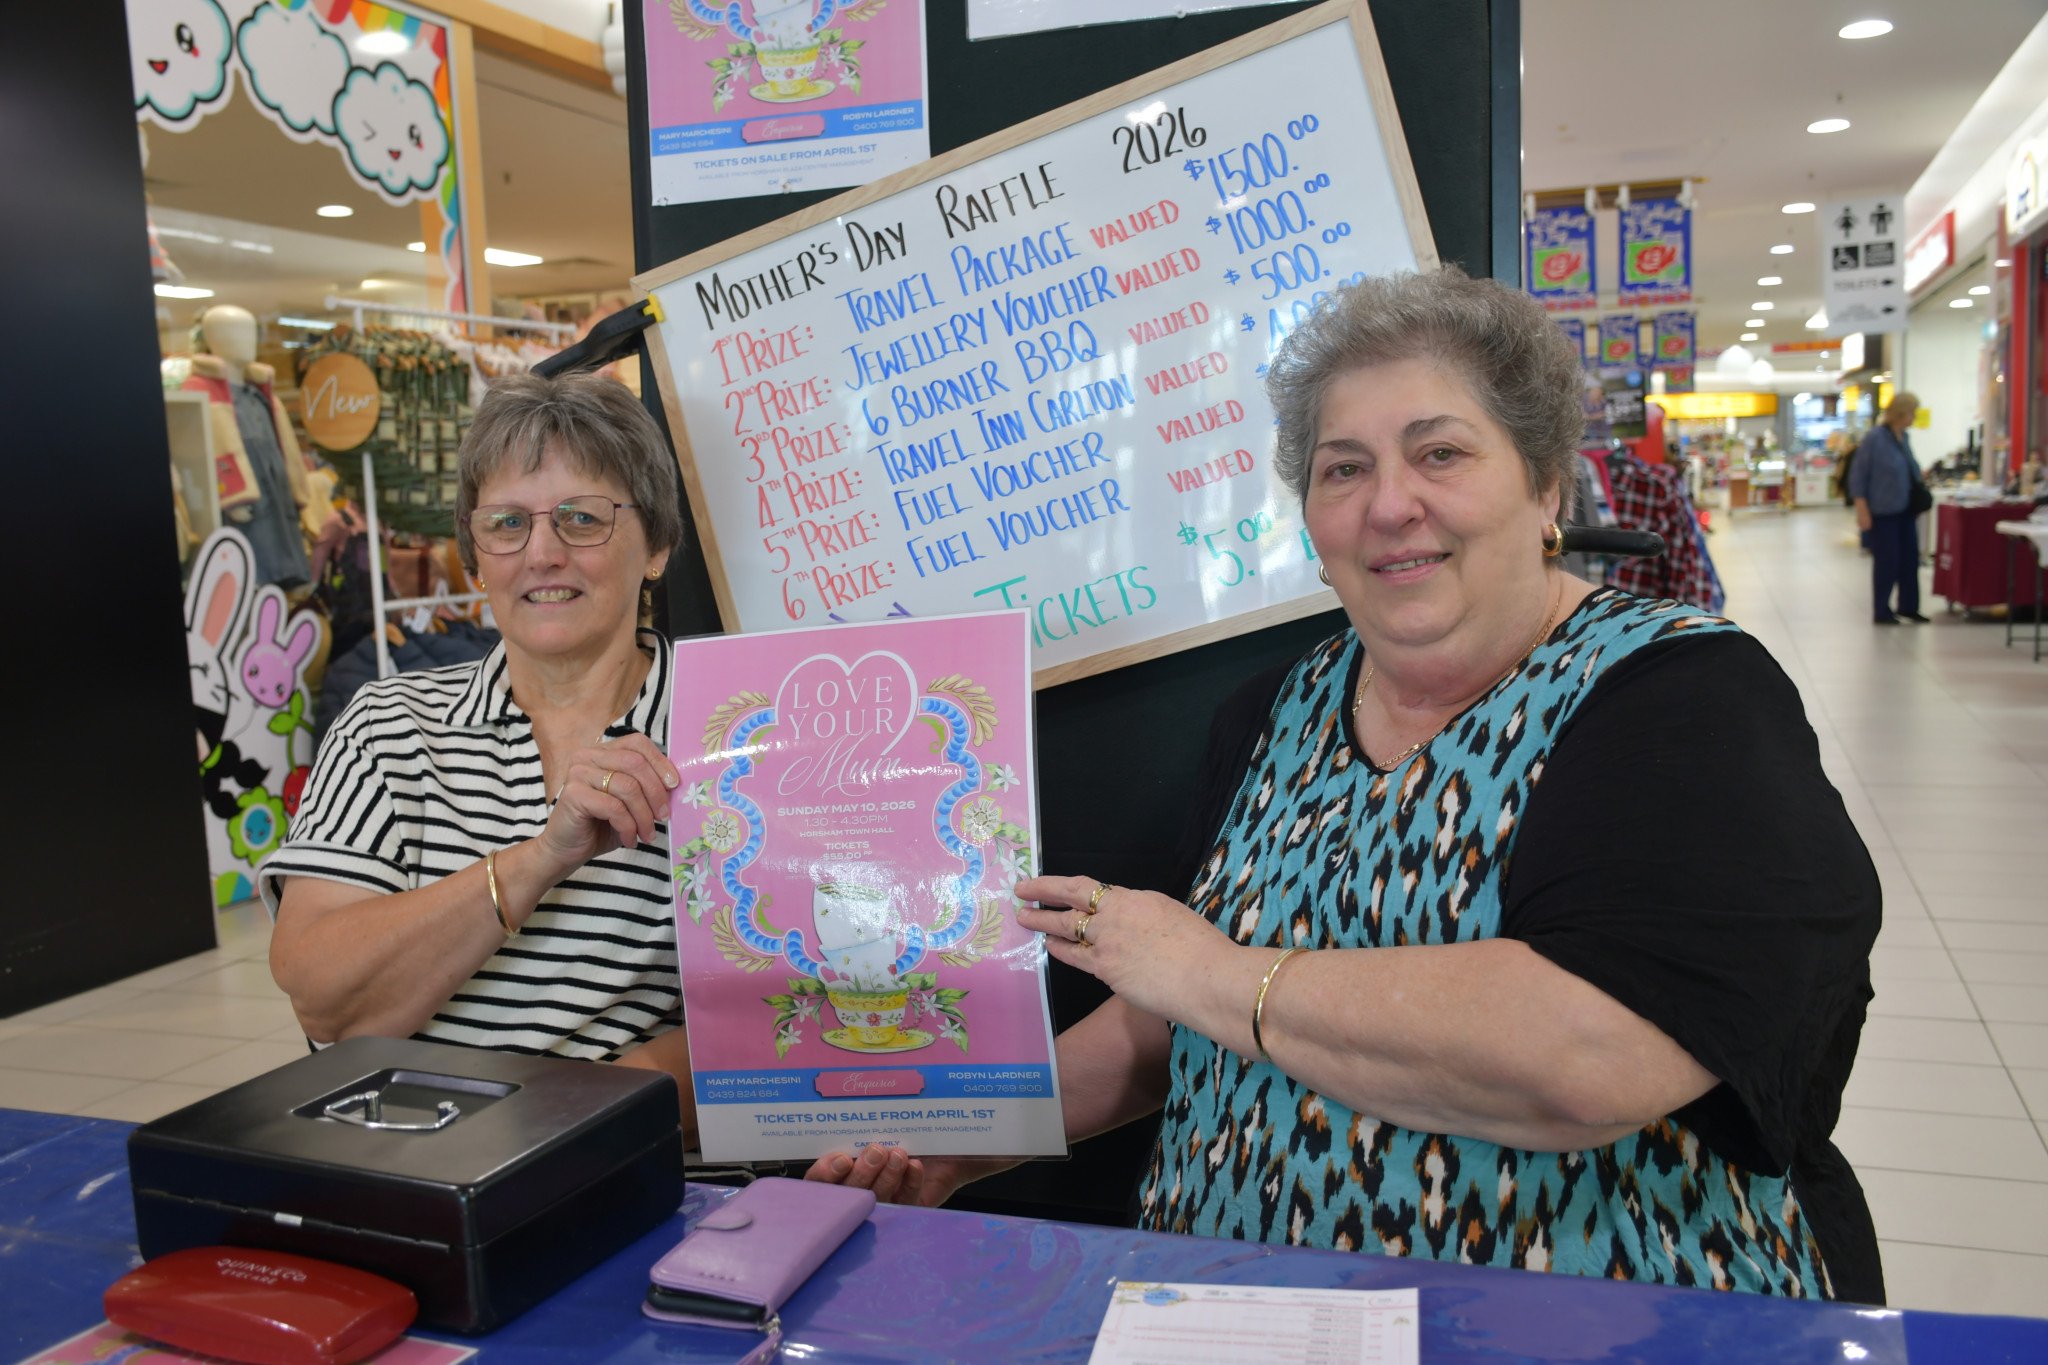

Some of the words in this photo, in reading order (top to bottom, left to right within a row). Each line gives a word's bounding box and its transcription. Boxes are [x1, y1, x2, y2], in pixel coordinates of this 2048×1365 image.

[842, 112, 872, 121] ROBYN
[873, 107, 914, 117] LARDNER
[659, 132, 680, 141] MARY
[681, 126, 732, 138] MARCHESINI
[694, 158, 738, 169] TICKETS
[740, 156, 757, 165] ON
[759, 153, 787, 163] SALE
[789, 150, 822, 161] FROM
[824, 147, 856, 157] APRIL
[858, 144, 877, 153] 1ST
[695, 241, 838, 331] MOTHER'S
[845, 221, 907, 272] DAY
[935, 161, 1065, 239] RAFFLE
[1112, 106, 1207, 174] 2026
[834, 272, 946, 335] TRAVEL
[950, 221, 1081, 297] PACKAGE
[1089, 198, 1180, 250] VALUED
[841, 306, 988, 391] JEWELLERY
[991, 265, 1117, 337] VOUCHER
[1115, 247, 1201, 296] VALUED
[862, 397, 890, 437] 6
[891, 360, 1010, 428] BURNER
[1014, 319, 1106, 385] BBQ
[1128, 301, 1210, 347] VALUED
[303, 374, 376, 420] New
[867, 428, 977, 486] TRAVEL
[971, 408, 1027, 453] INN
[1028, 372, 1136, 433] CARLTON
[1144, 351, 1229, 396] VALUED
[893, 483, 974, 532] FUEL
[970, 431, 1111, 502] VOUCHER
[1156, 399, 1245, 444] VALUED
[906, 531, 987, 579] FUEL
[986, 478, 1131, 552] VOUCHER
[1167, 448, 1255, 494] VALUED
[793, 676, 893, 709] LOVE
[788, 708, 896, 740] YOUR
[777, 805, 829, 817] SUNDAY
[831, 803, 859, 813] MAY
[860, 802, 879, 813] 10,
[881, 800, 916, 811] 2026
[804, 817, 828, 827] 1.30
[840, 815, 888, 825] 4.30PM
[800, 829, 843, 838] HORSHAM
[844, 828, 870, 836] TOWN
[871, 826, 894, 834] HALL
[824, 841, 870, 850] TICKETS
[706, 1078, 736, 1086] MARY
[737, 1077, 801, 1085] MARCHESINI
[948, 1071, 987, 1080] ROBYN
[988, 1071, 1041, 1079] LARDNER
[707, 1090, 737, 1099] 0439
[737, 1089, 758, 1098] 824
[759, 1089, 779, 1098] 684
[963, 1084, 994, 1092] 0400
[997, 1084, 1017, 1092] 769
[1018, 1084, 1042, 1092] 900
[754, 1113, 813, 1124] TICKETS
[816, 1113, 837, 1123] ON
[840, 1112, 877, 1122] SALE
[881, 1110, 923, 1120] FROM
[926, 1109, 969, 1119] APRIL
[971, 1109, 996, 1118] 1ST
[829, 1128, 871, 1136] HORSHAM
[216, 1258, 270, 1274] QUINN
